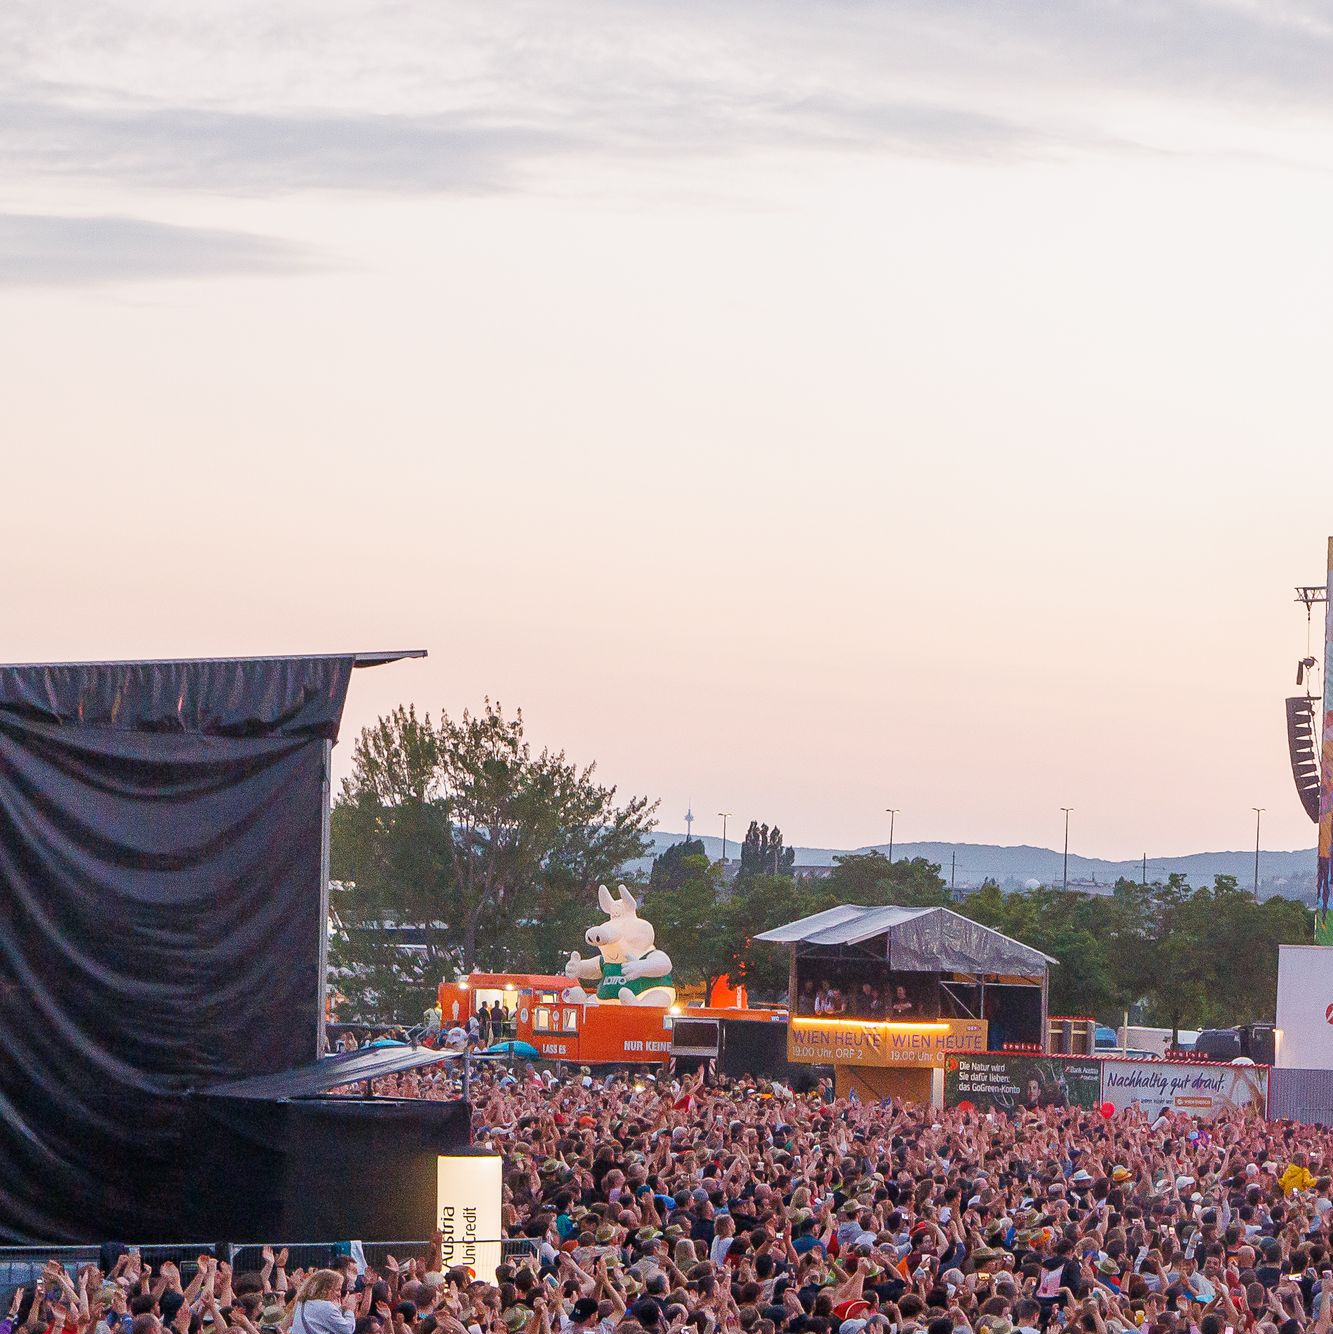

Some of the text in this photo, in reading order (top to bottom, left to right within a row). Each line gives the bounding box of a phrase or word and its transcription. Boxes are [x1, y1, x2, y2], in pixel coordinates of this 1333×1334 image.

[793, 1030, 881, 1047] WIEN HEUTE
[892, 1034, 982, 1050] WIEN HEUTE
[624, 1041, 643, 1051] NUR
[836, 1049, 854, 1059] ORF
[857, 1050, 863, 1060] 2
[959, 1062, 1005, 1072] Die Natur wird
[959, 1072, 969, 1081] Sie
[971, 1073, 988, 1083] dafür
[1107, 1073, 1225, 1095] Nachhaltig gut drauf.
[959, 1082, 1021, 1094] das GoGreen-Konto
[440, 1206, 454, 1267] Austria
[462, 1207, 476, 1265] UniCredit
